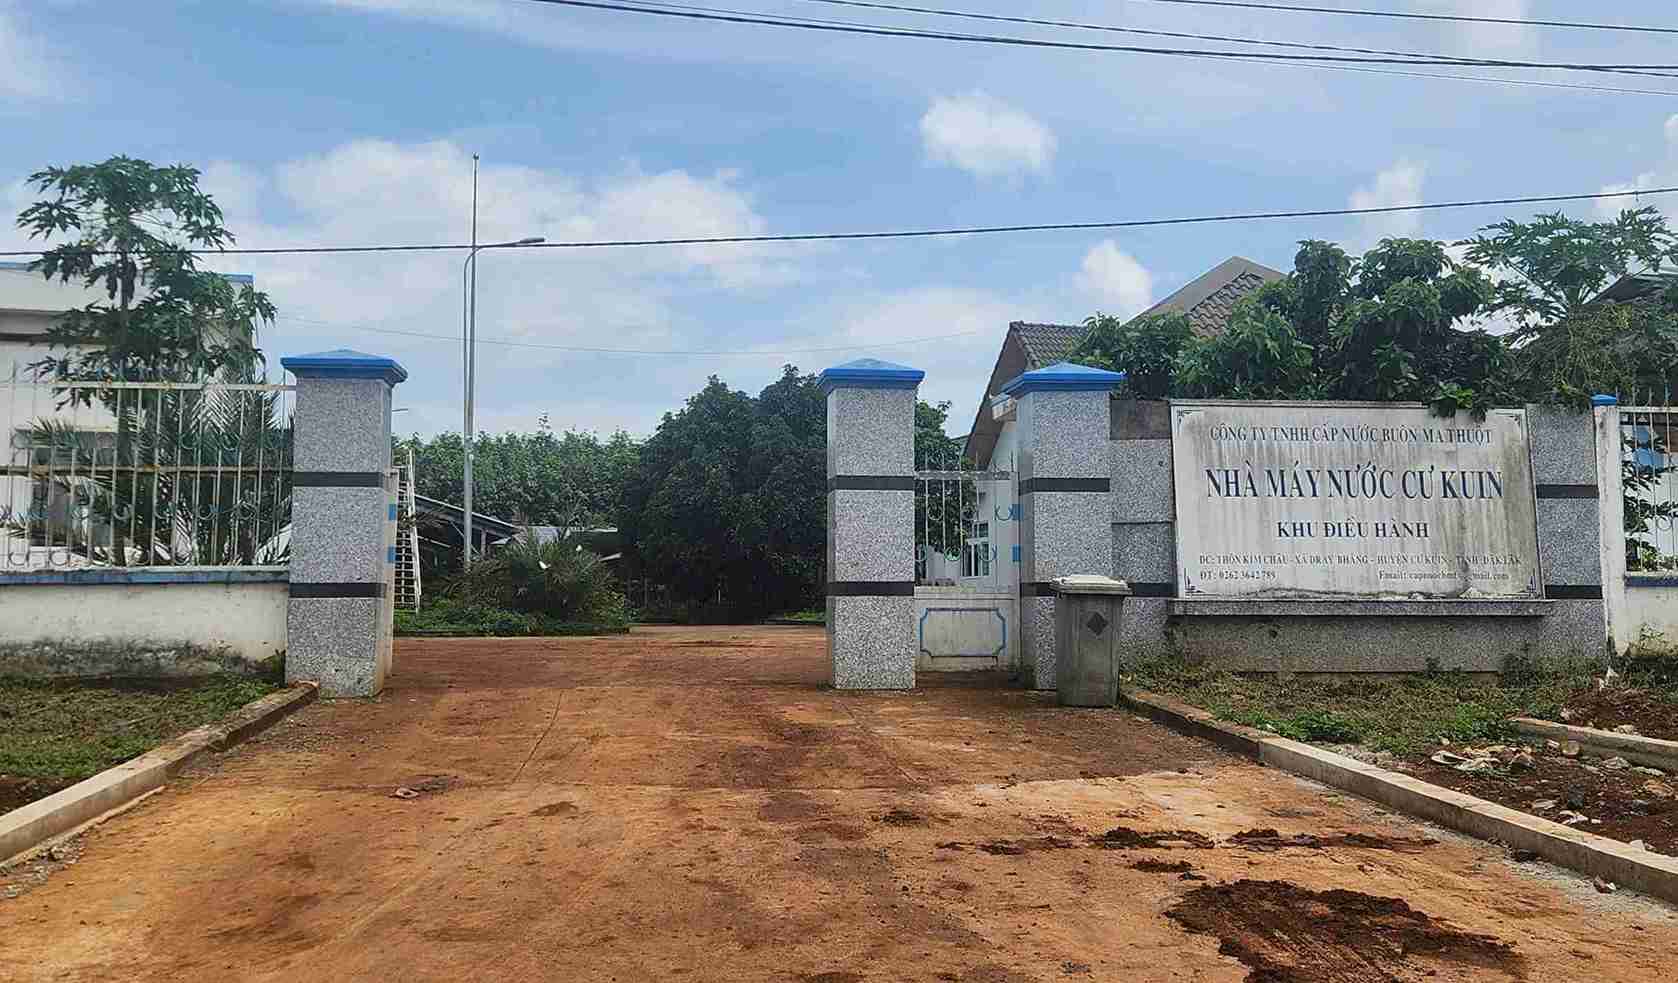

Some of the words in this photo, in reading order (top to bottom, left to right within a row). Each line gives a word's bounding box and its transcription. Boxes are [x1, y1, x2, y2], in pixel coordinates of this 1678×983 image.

[1210, 422, 1247, 441] CÔNG
[1252, 425, 1268, 441] TY
[1270, 424, 1309, 441] TNHH
[1342, 422, 1378, 442] NƯỚC
[1423, 427, 1444, 443] MA
[1445, 423, 1492, 447] THUỘT
[1205, 460, 1258, 498] NHÀ
[1264, 460, 1321, 498] MÁY
[1327, 461, 1394, 499] NƯỚC
[1401, 464, 1435, 499] CƯ
[1440, 470, 1503, 499] KUIN
[1277, 521, 1318, 538] KHU
[1323, 515, 1369, 538] ĐIỀU
[1375, 518, 1430, 538] HÀNH
[1242, 554, 1262, 565] KIM
